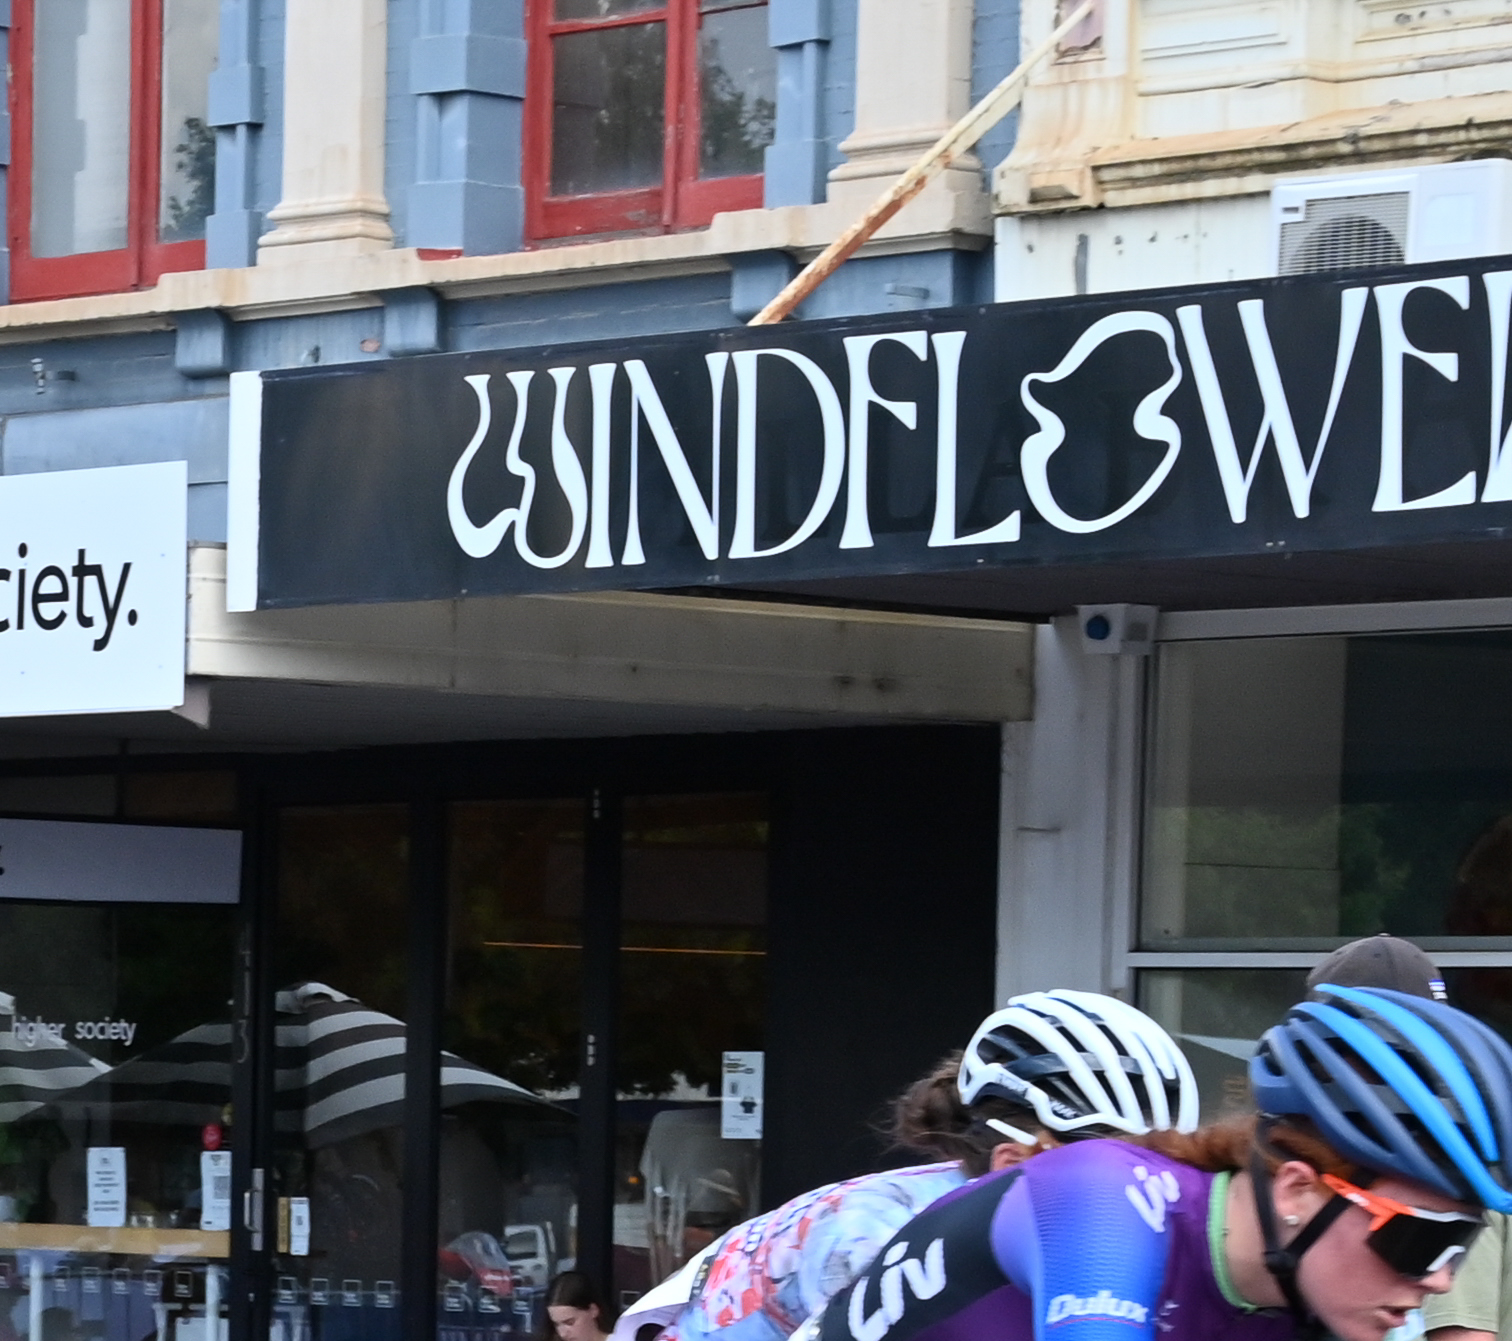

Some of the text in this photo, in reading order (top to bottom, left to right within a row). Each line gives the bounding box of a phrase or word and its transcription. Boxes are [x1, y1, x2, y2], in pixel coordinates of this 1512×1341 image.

[12, 1015, 137, 1047] higher society
[1045, 1290, 1150, 1325] Dulux
